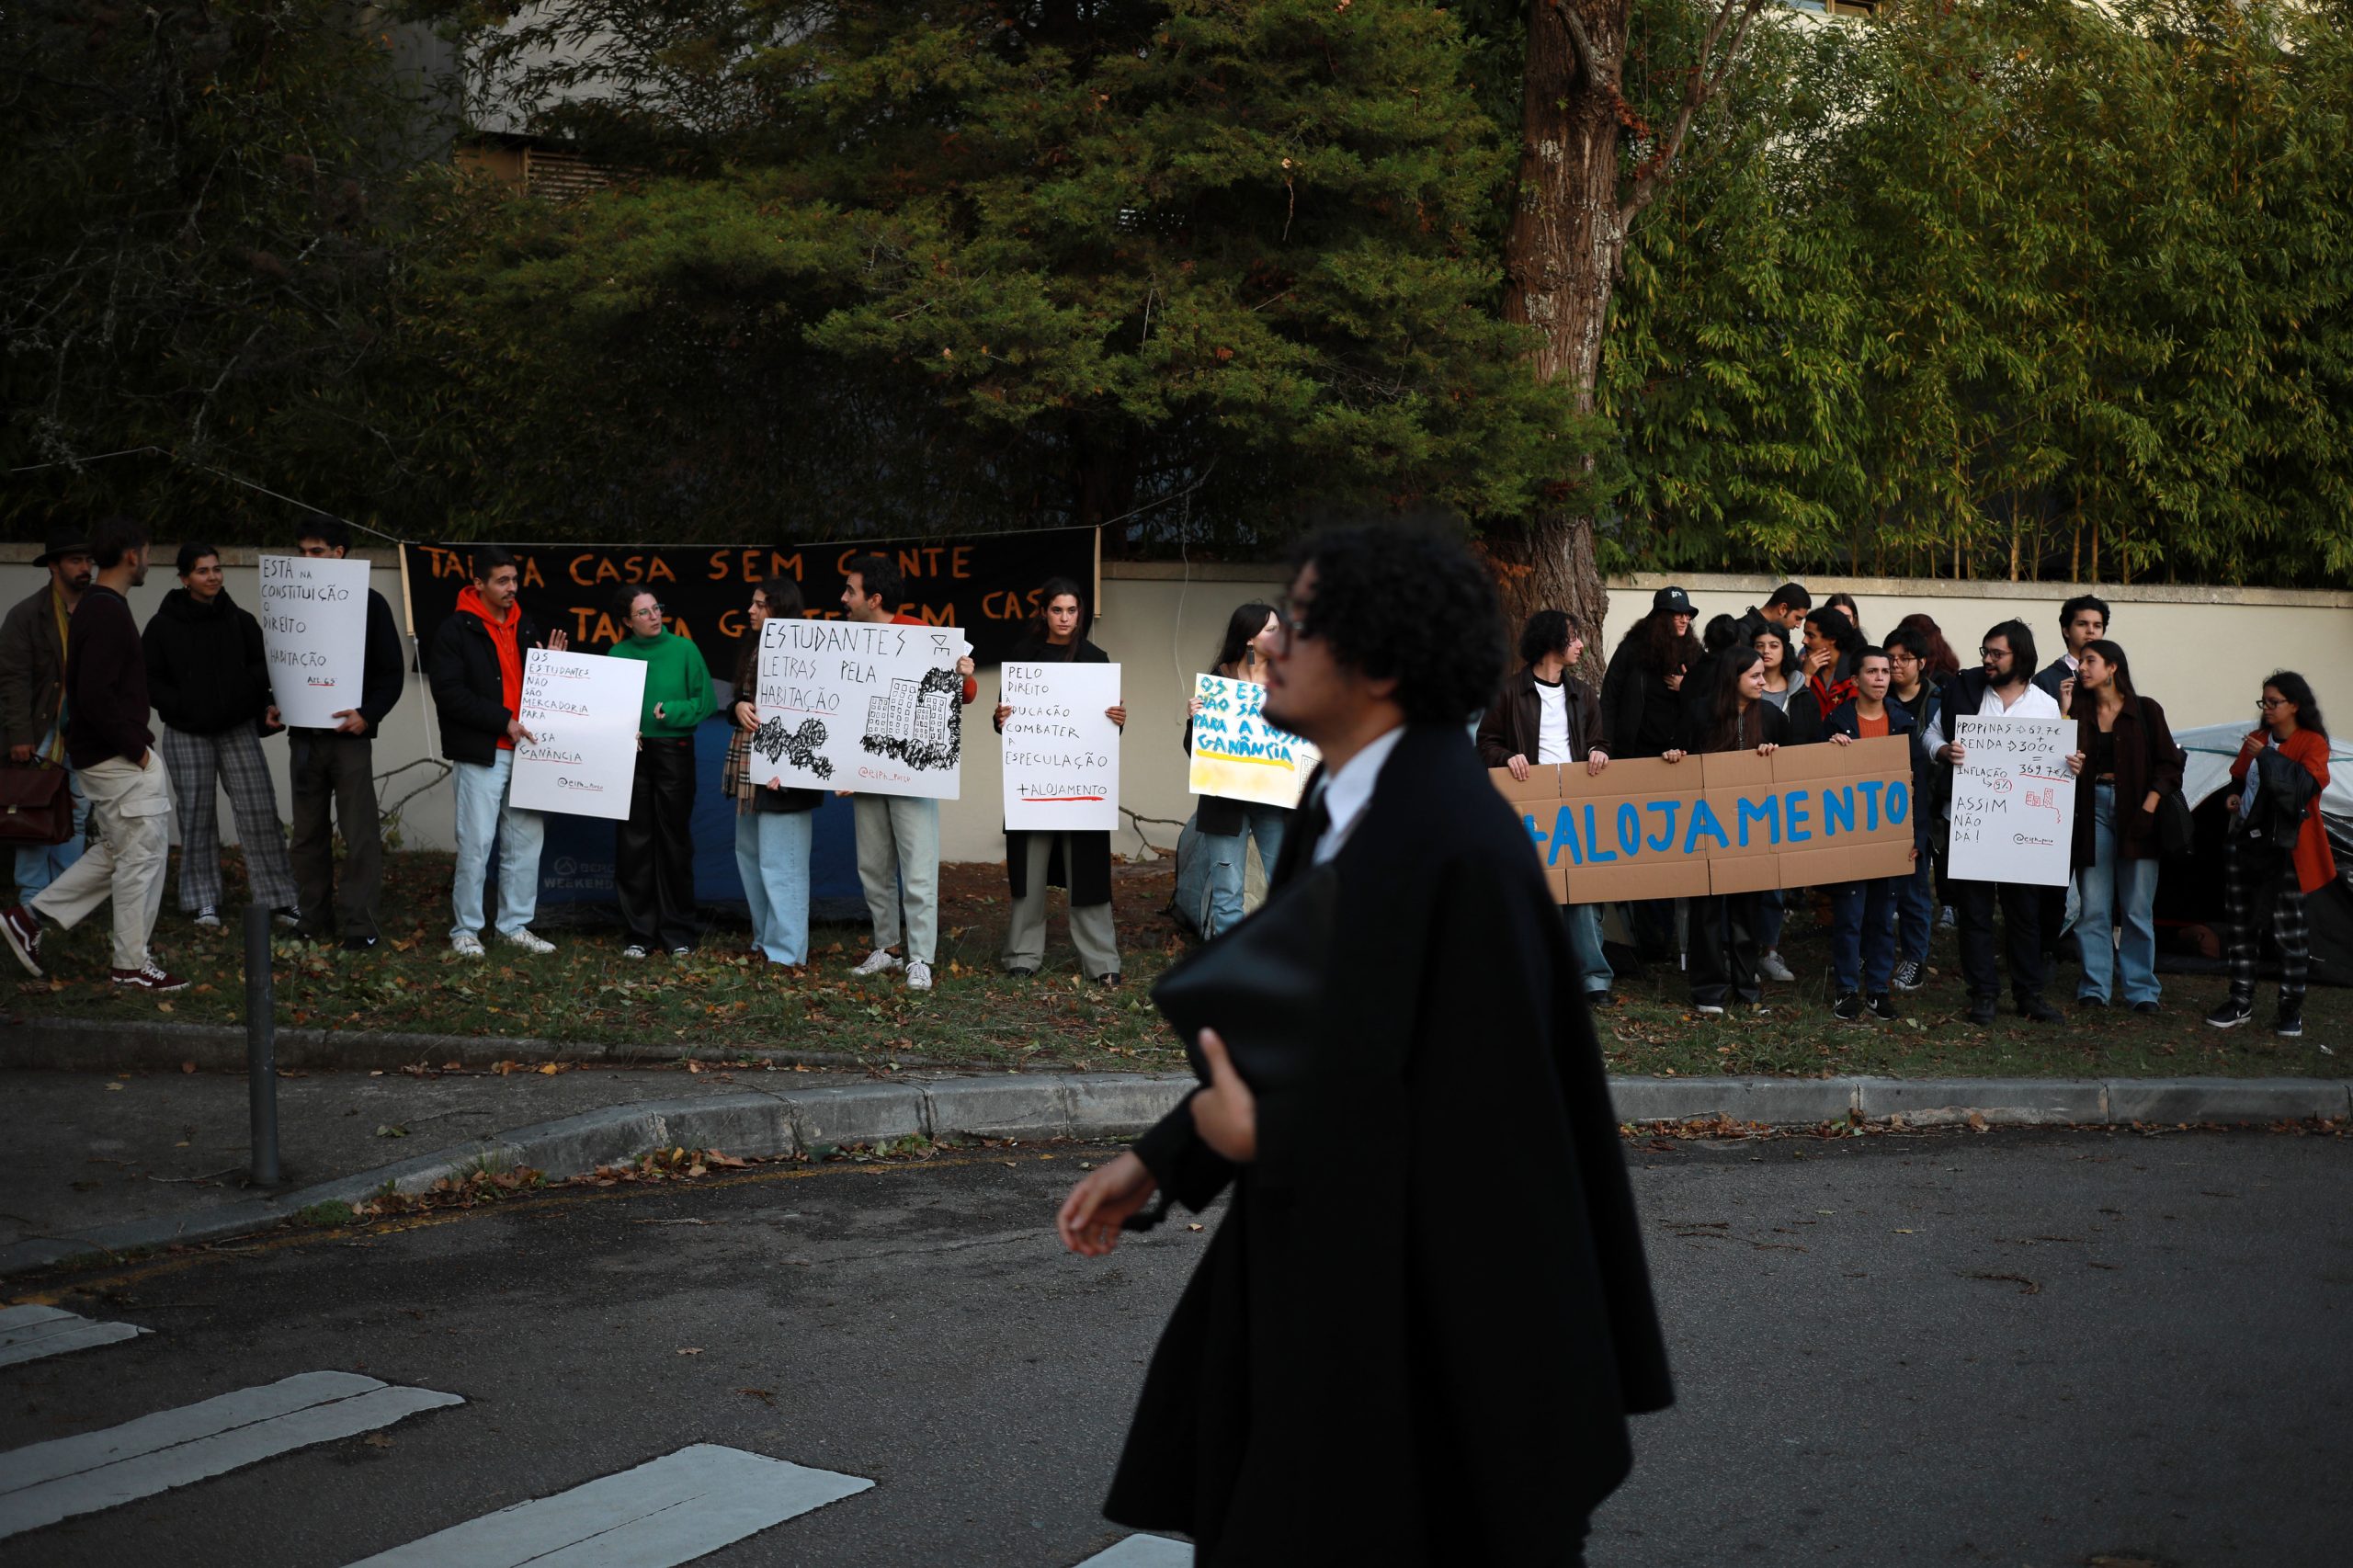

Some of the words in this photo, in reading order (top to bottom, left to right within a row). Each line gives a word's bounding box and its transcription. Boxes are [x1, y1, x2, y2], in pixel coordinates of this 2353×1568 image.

[264, 558, 293, 578] ESTÁ
[300, 571, 312, 579] NA
[569, 553, 676, 586] CASA
[708, 550, 803, 582] SEM
[262, 584, 349, 602] CONSTITUIÇÃO
[264, 602, 269, 611] O
[981, 587, 1045, 619] CAS
[263, 614, 306, 632] DIREITO
[765, 623, 905, 656] ESTUDANTES
[270, 650, 326, 668] HABITAÇÃO
[531, 652, 548, 663] OS
[529, 663, 589, 677] ESTUDANTES
[762, 656, 816, 680] LETRAS
[841, 660, 876, 683] PELA
[1008, 666, 1042, 678] PELO
[527, 675, 548, 687] NÃO
[1008, 681, 1049, 696] DIREITO
[1200, 676, 1228, 698] OS
[523, 697, 588, 713] MERCADORIA
[761, 683, 840, 711] HABITAÇÃO
[521, 709, 545, 720] PARA
[1011, 705, 1070, 717] DUCAÇÃO
[1006, 723, 1080, 739] COMBATER
[1194, 713, 1228, 733] PARA
[1238, 720, 1254, 735] A
[1956, 722, 2012, 734] PROPINAS
[1008, 737, 1016, 745] A
[1960, 738, 2003, 750] RENDA
[2018, 741, 2055, 753] 300€
[1006, 751, 1107, 769] ESPECULAÇÃO
[1957, 766, 2007, 778] INFLAÇÃO
[1956, 796, 2006, 813] ASSIM
[1953, 812, 1982, 827] NÃO
